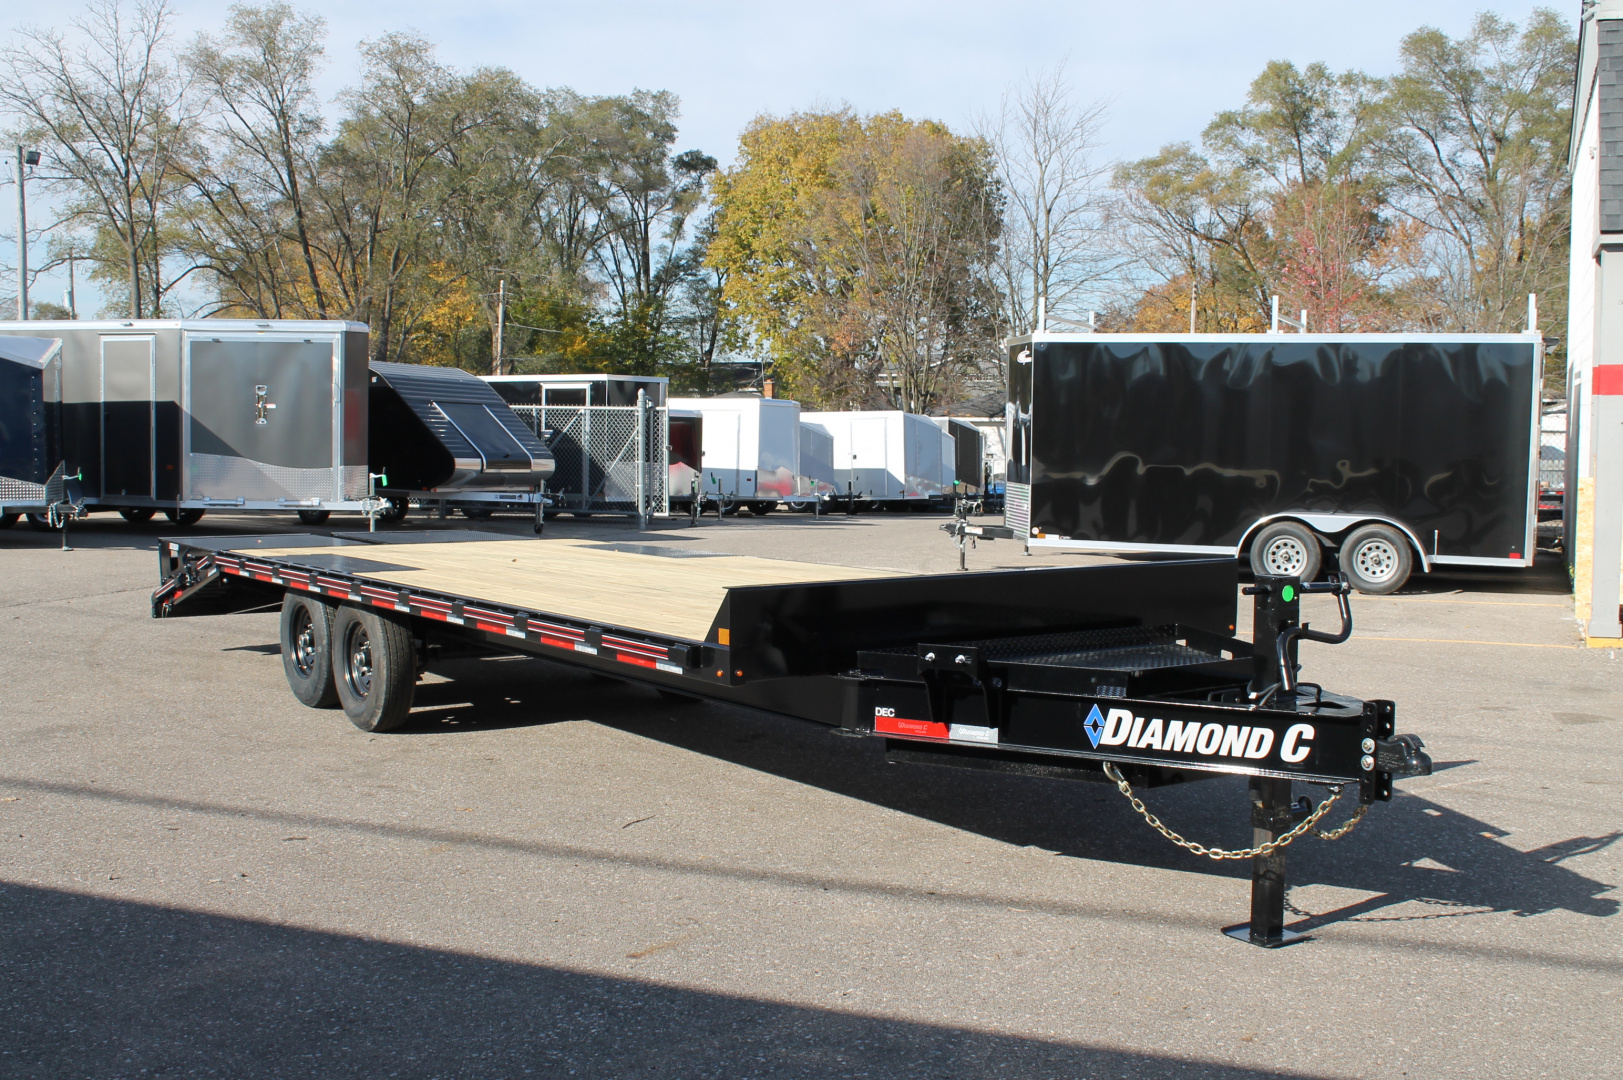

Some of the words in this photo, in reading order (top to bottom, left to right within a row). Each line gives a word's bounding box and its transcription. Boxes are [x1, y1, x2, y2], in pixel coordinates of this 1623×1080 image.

[875, 707, 895, 717] DEC
[1100, 708, 1275, 759] DIAMOND
[1280, 723, 1316, 763] C
